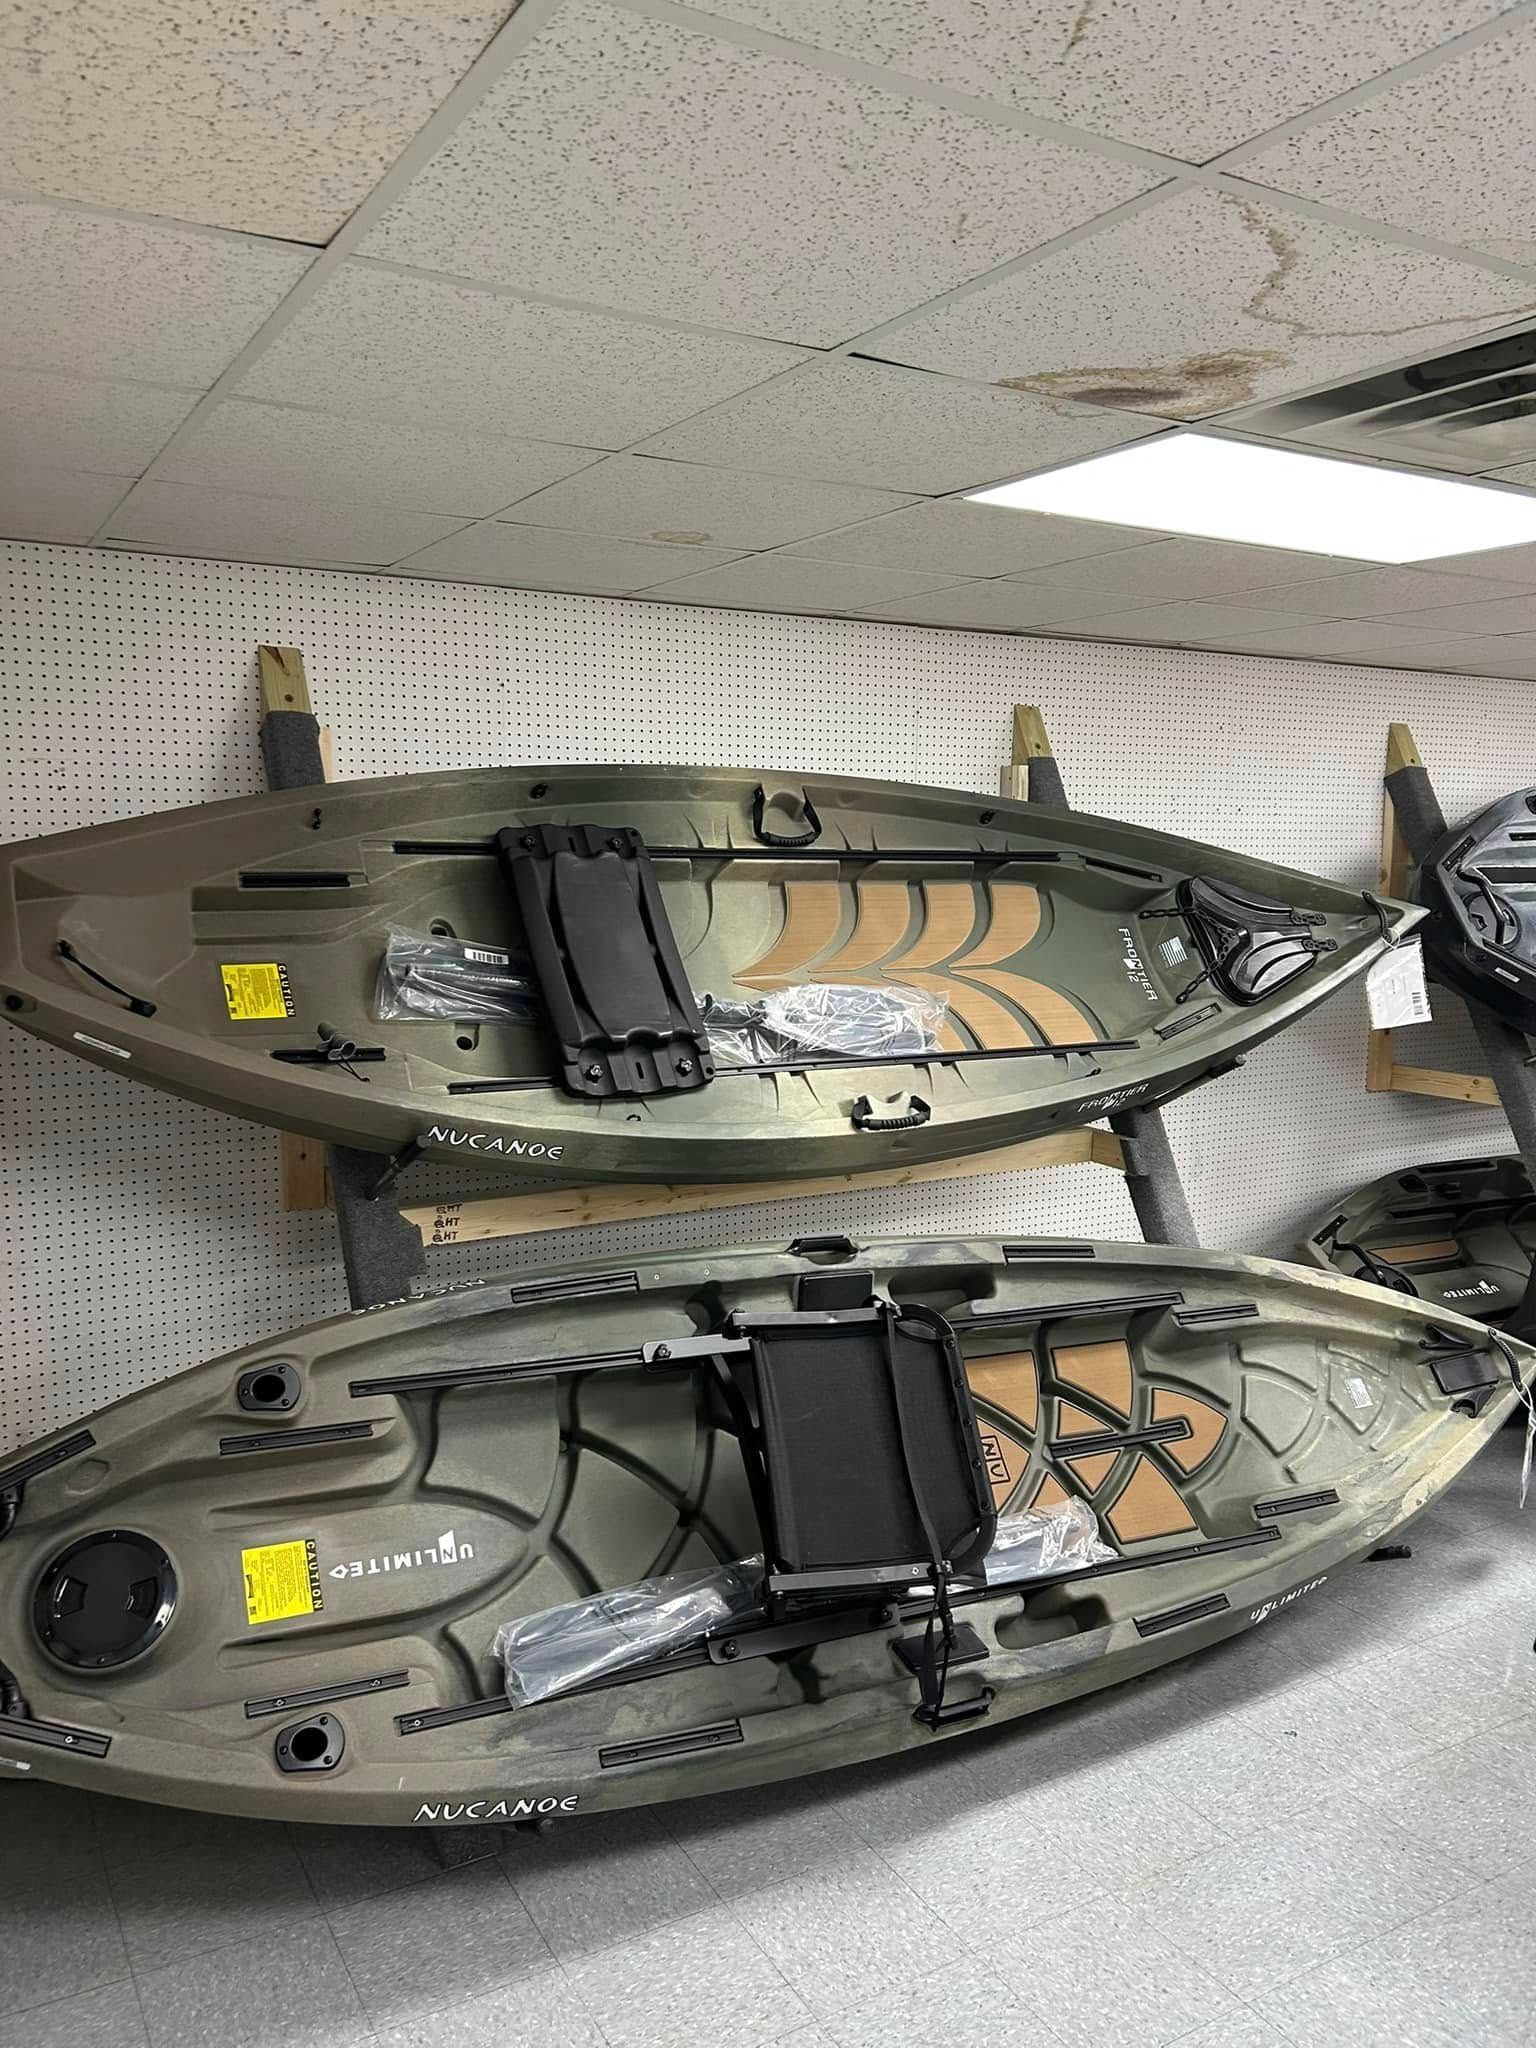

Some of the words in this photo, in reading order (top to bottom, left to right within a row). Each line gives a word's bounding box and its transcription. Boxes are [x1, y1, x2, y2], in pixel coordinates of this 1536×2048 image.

[1118, 928, 1158, 1000] FRONTIER
[279, 965, 296, 1016] CAUTION
[427, 1126, 563, 1160] NUCANOE
[306, 1541, 324, 1609] CAUTION
[328, 1529, 474, 1579] UNLIMITED
[413, 1795, 578, 1822] NUCANOE
